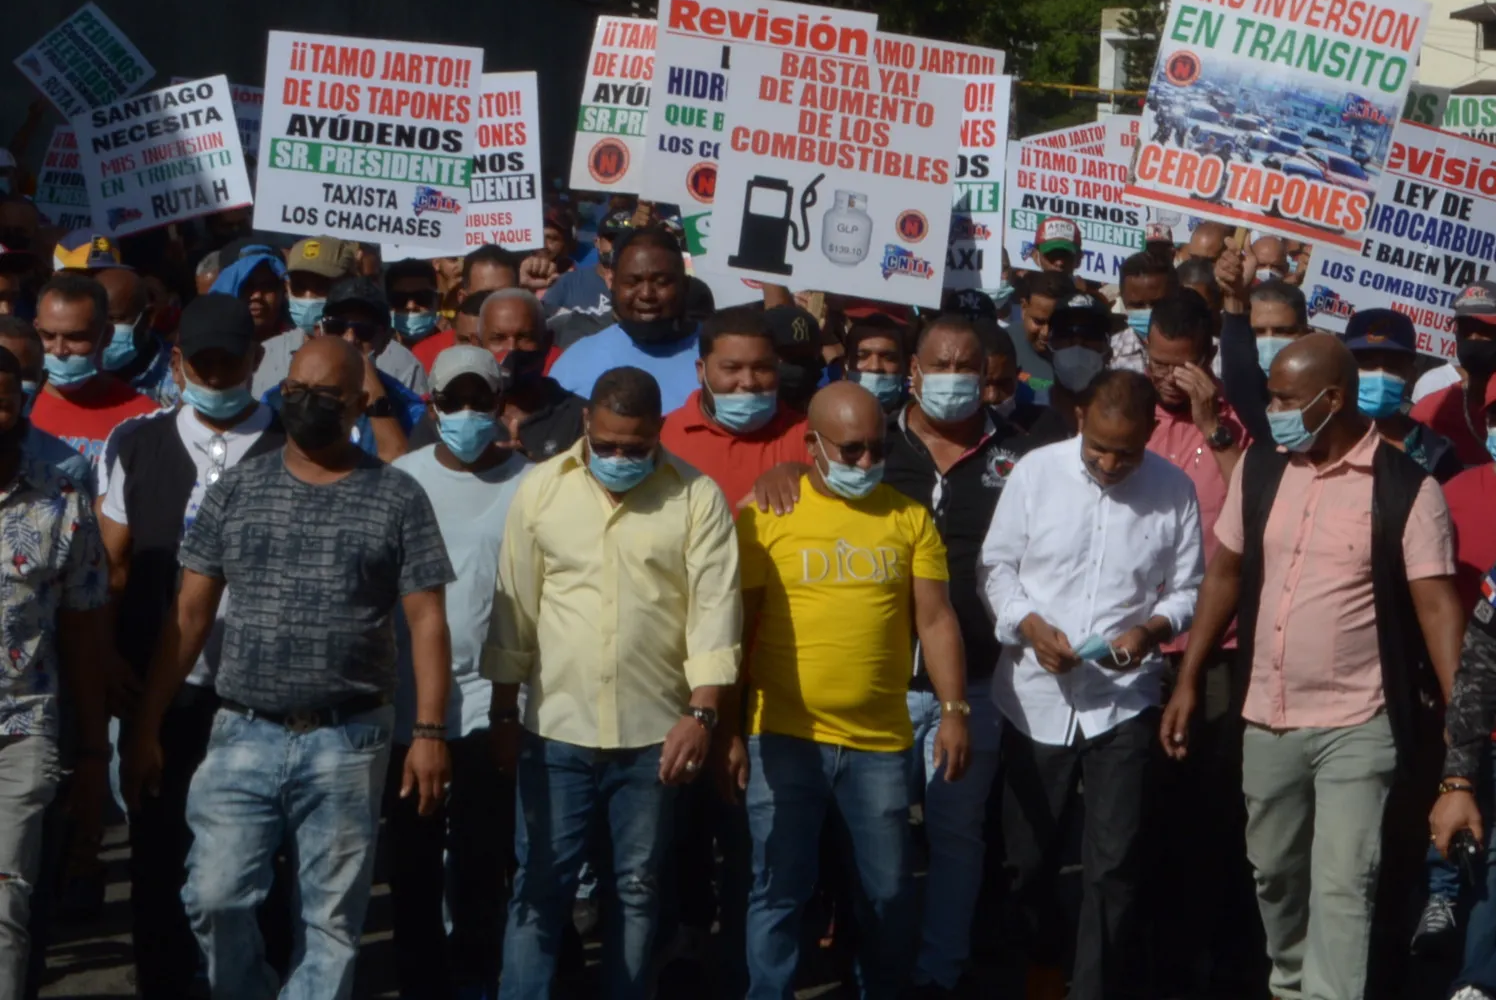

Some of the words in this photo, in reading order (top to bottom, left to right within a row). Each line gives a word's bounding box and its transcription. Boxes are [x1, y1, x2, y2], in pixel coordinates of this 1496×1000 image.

[70, 10, 147, 85] PEDIMOS
[592, 52, 619, 78] DE
[619, 54, 656, 81] LOS
[1170, 4, 1225, 49] EN
[1232, 17, 1408, 93] TRANSITO
[380, 51, 472, 89] JARTO!!
[667, 66, 729, 103] HIDR
[780, 51, 870, 91] BASTA
[878, 67, 920, 99] YA!
[91, 83, 213, 128] SANTIAGO
[282, 77, 313, 107] DE
[317, 81, 361, 112] LOS
[367, 86, 471, 124] TAPONES
[592, 81, 651, 107] AYÚ
[759, 74, 795, 105] DE
[799, 82, 935, 129] AUMENTO
[91, 106, 223, 154] NECESITA
[286, 113, 463, 153] AYÚDENOS
[664, 103, 709, 129] QUE
[797, 109, 833, 139] DE
[839, 116, 891, 148] LOS
[100, 154, 136, 179] MAS
[142, 132, 224, 166] INVERSION
[275, 140, 313, 170] SR.
[319, 146, 467, 186] PRESIDENTE
[658, 132, 694, 156] LOS
[730, 125, 950, 186] COMBUSTIBLES
[100, 178, 125, 199] EN
[134, 150, 232, 188] TRANSITO
[1017, 170, 1037, 191] DE
[1041, 174, 1070, 196] LOS
[1137, 144, 1223, 198] CERO
[1226, 161, 1367, 233] TAPONES
[151, 184, 209, 219] RUTA
[212, 178, 229, 202] H
[321, 182, 399, 210] TAXISTA
[1021, 193, 1139, 226] AYÚDENOS
[1393, 179, 1439, 211] LEY
[1440, 191, 1474, 222] DE
[281, 204, 319, 226] LOS
[324, 208, 442, 239] CHACHASES
[465, 232, 489, 246] DEL
[491, 228, 532, 245] YAQUE
[836, 223, 860, 235] GLP
[886, 254, 931, 274] CNTT
[1320, 259, 1356, 283] LOS
[1375, 241, 1441, 277] BAJEN
[800, 539, 903, 583] DIOR
